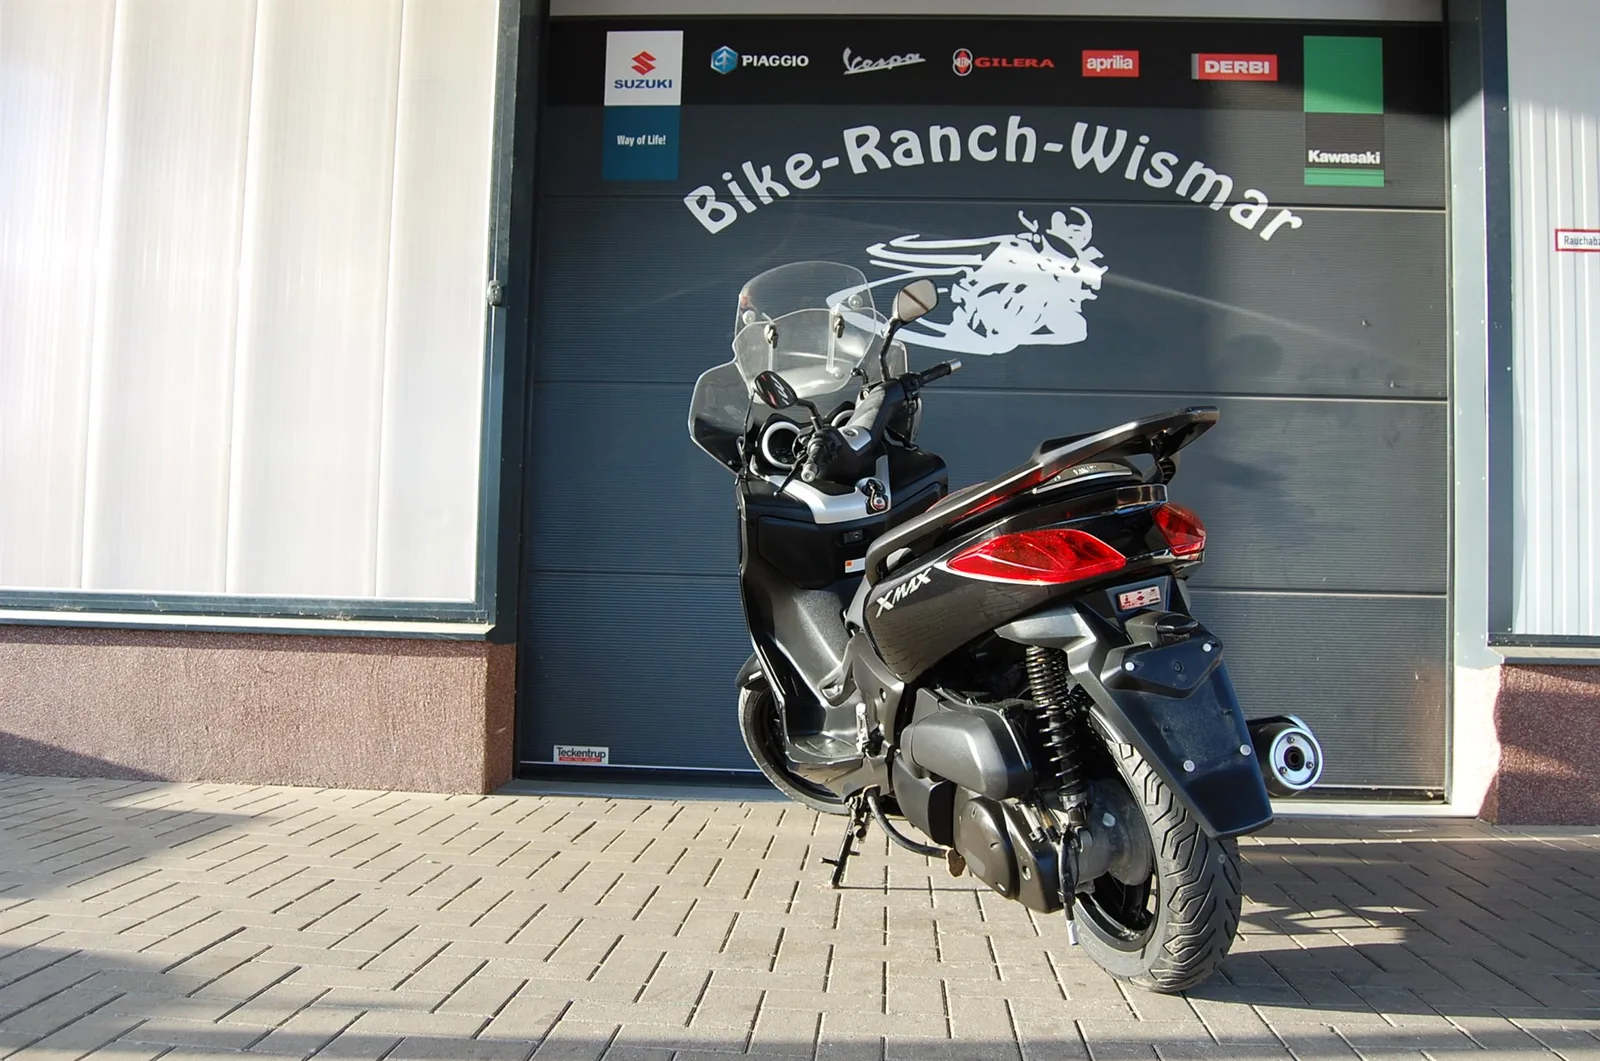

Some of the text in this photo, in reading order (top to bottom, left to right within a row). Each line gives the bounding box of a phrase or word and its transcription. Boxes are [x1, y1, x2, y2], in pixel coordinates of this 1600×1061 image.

[742, 55, 809, 67] PIAGGIO
[843, 48, 925, 75] Vespa
[974, 57, 1054, 68] GILERA
[1086, 54, 1133, 72] aprilia
[1204, 60, 1270, 74] DERBI
[614, 79, 672, 89] SUZUKI
[617, 134, 666, 147] Way of Life!
[1308, 149, 1381, 164] Kawasaki
[683, 115, 1303, 241] Bike-Ranch-Wismar
[556, 747, 606, 761] Teckentrup
